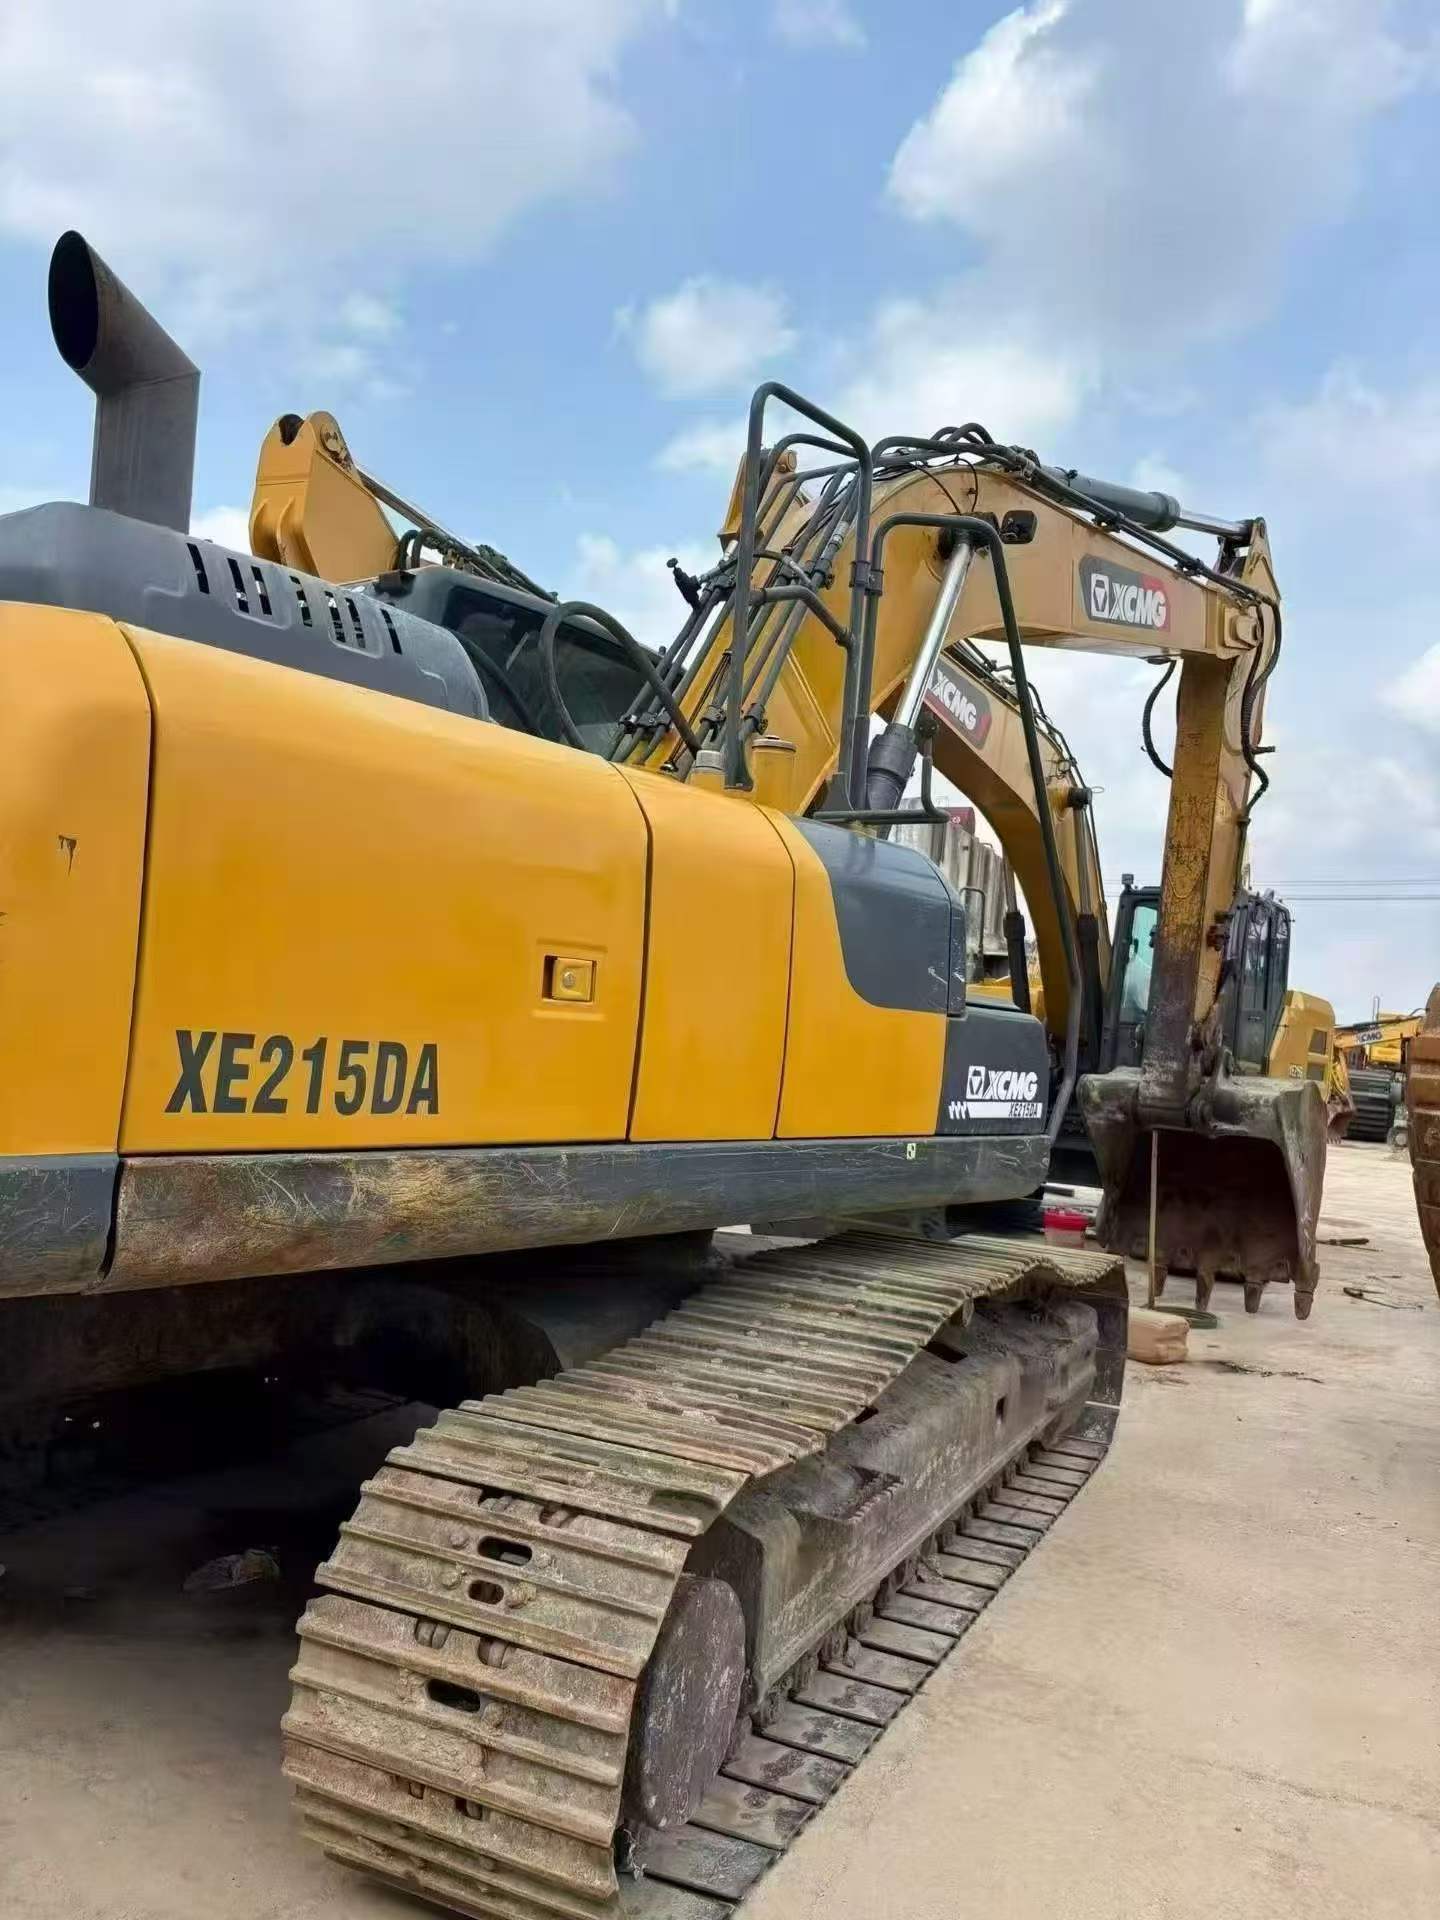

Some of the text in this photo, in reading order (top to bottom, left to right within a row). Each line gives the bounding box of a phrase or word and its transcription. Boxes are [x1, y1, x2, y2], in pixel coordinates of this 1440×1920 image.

[1109, 582, 1167, 627] XCMG
[931, 669, 977, 731] XCMG
[165, 1029, 440, 1116] XE215DA
[984, 1070, 1038, 1101] XCMG
[1008, 1102, 1038, 1118] XE215DA
